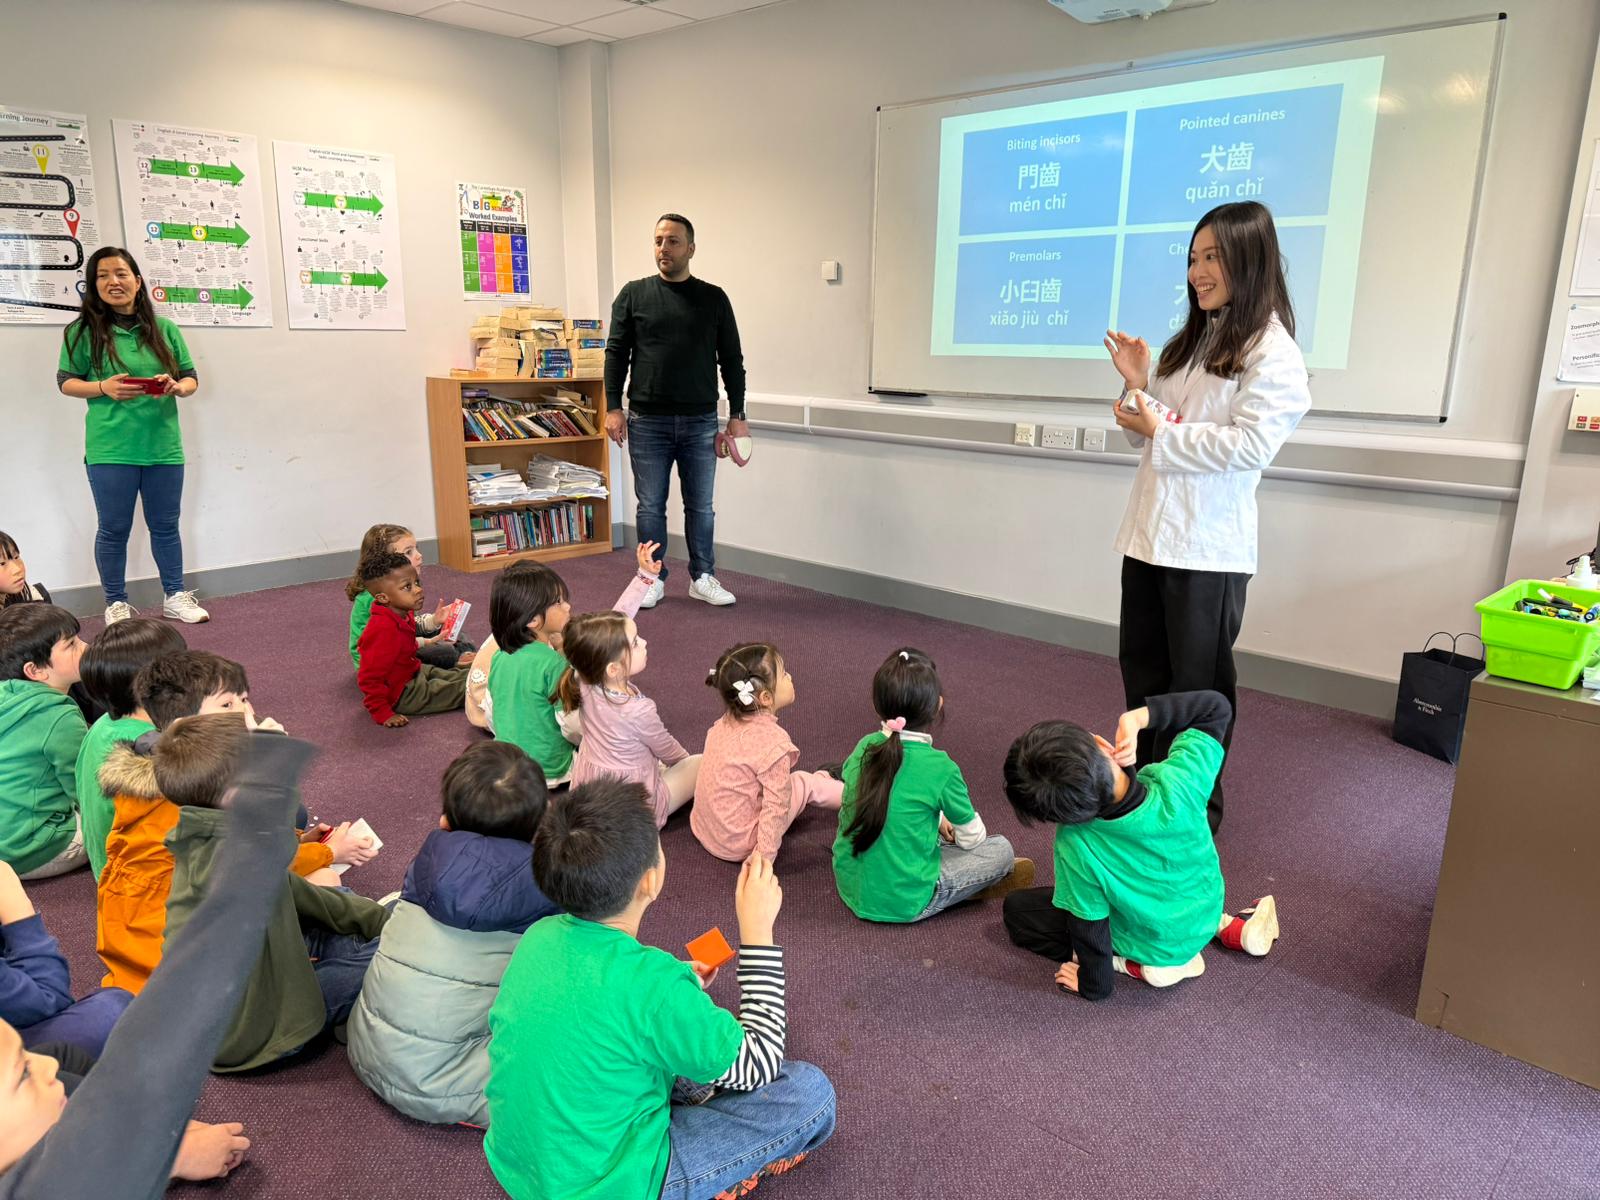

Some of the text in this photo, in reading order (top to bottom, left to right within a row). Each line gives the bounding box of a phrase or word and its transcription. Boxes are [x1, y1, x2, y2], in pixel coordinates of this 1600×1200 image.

[22, 115, 49, 125] Journey
[1180, 109, 1286, 130] Pointed canines
[1007, 133, 1081, 151] Biting incisors
[1200, 142, 1255, 174] 犬齒
[1018, 161, 1061, 190] 門齒
[1009, 196, 1040, 213] mén
[469, 212, 518, 222] Worked Examples
[1009, 249, 1062, 263] Premolars
[1000, 277, 1062, 304] 小臼齒
[1020, 310, 1040, 328] jiù
